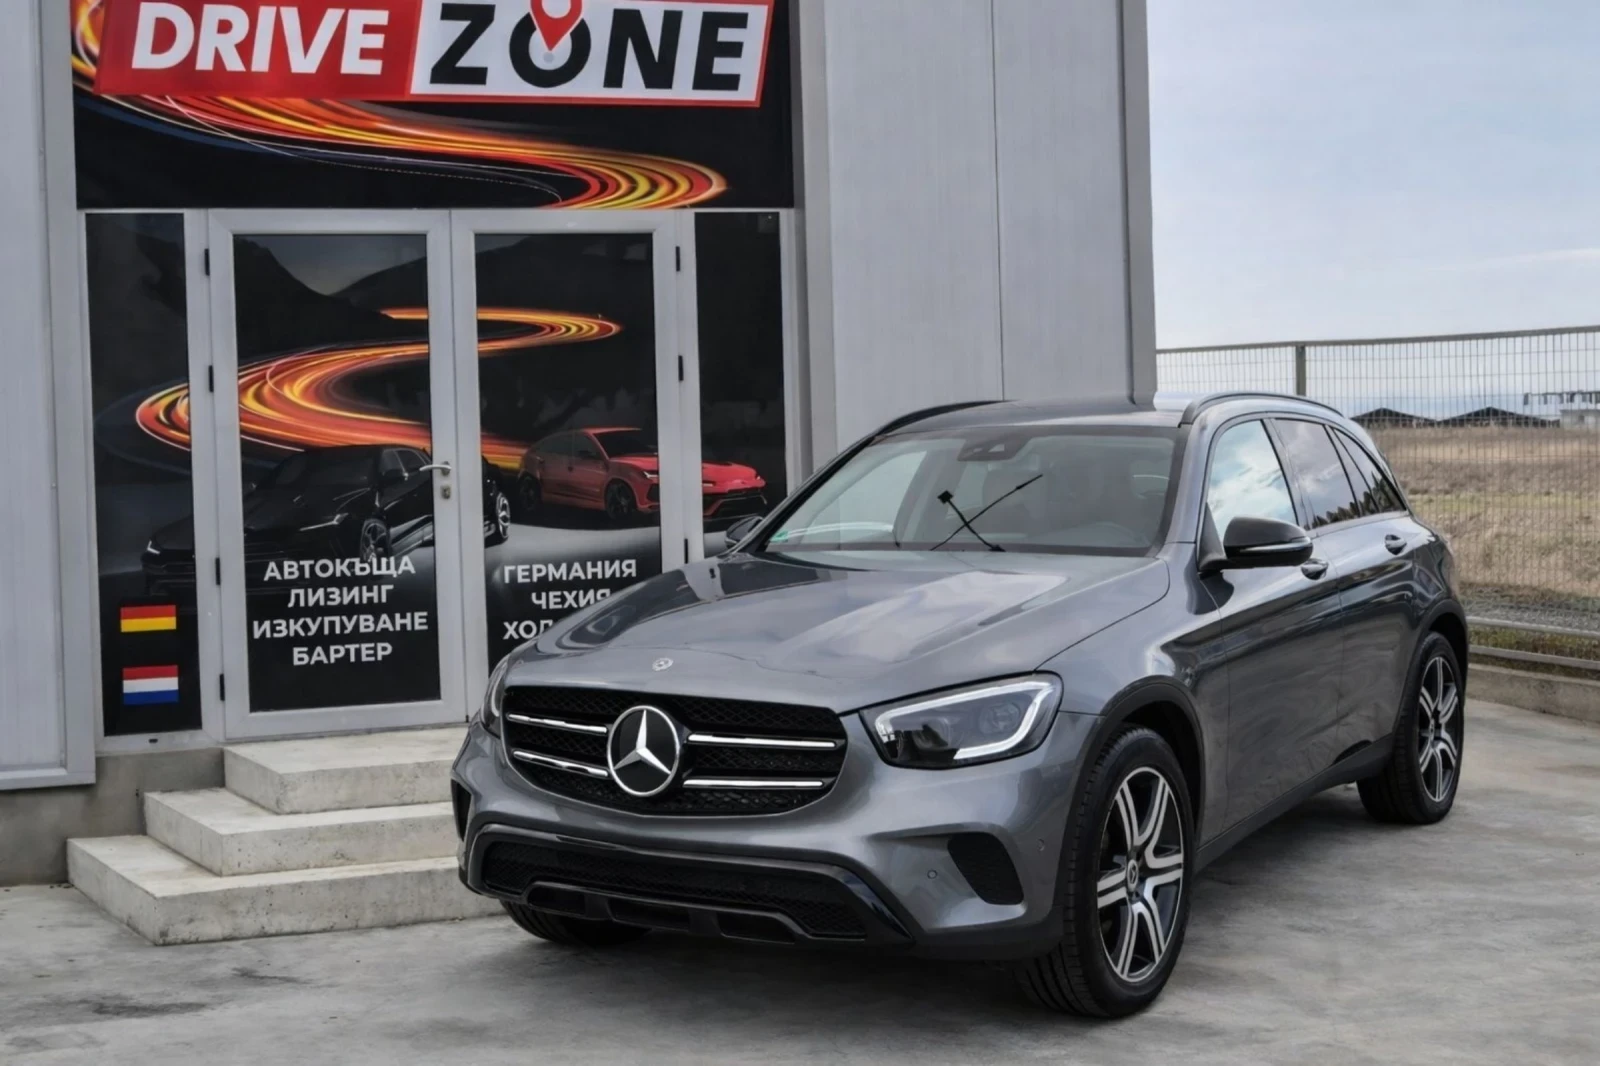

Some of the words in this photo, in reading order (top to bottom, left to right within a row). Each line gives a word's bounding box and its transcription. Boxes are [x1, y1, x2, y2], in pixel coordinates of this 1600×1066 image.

[132, 2, 389, 75] DRIVE
[430, 2, 749, 91] ZONE
[263, 555, 416, 581] АВТОКЪЩА
[503, 559, 637, 584] ГЕРМАНИЯ
[287, 584, 394, 608] ЛИЗИНГ
[253, 611, 429, 639] ИЗКУПУВАНЕ
[293, 642, 393, 666] БАРТЕР
